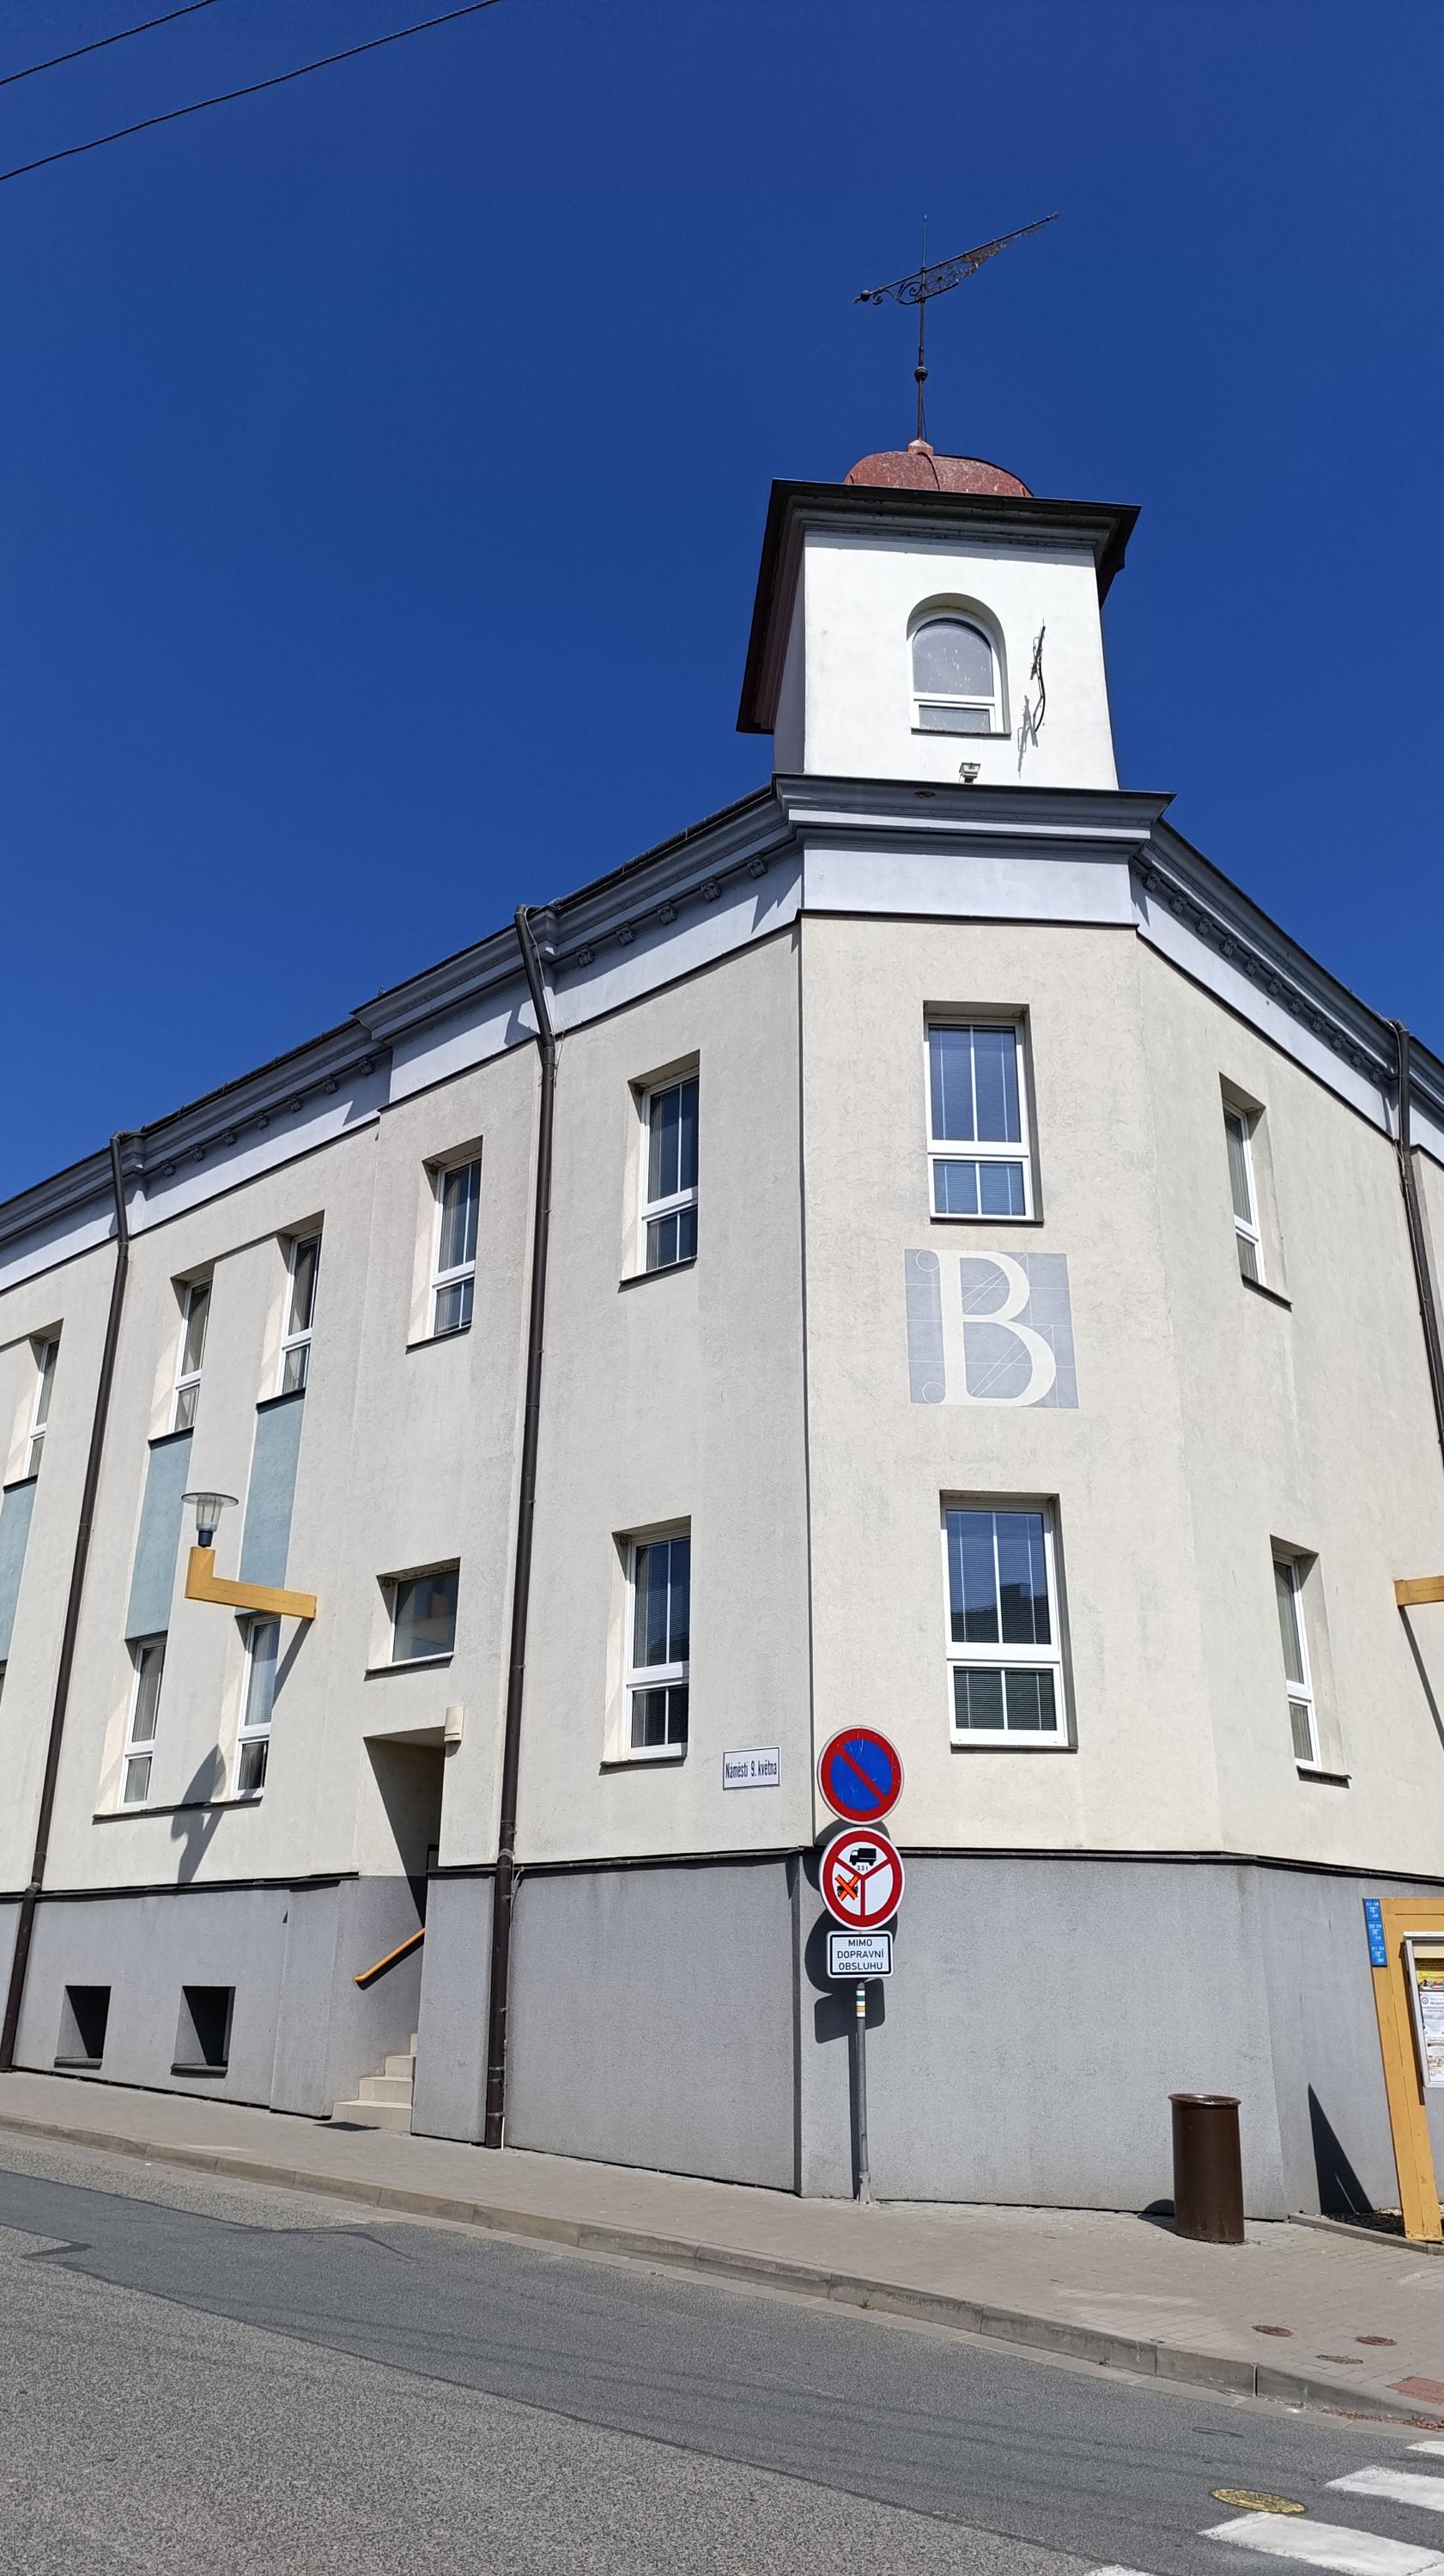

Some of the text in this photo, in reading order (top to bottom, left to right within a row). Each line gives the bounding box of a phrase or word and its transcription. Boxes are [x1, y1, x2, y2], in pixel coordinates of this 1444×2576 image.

[934, 1249, 1057, 1406] B
[757, 1759, 777, 1777] května
[837, 1948, 884, 1959] DOPRAVNÍ
[838, 1961, 883, 1971] OBSLUHU
